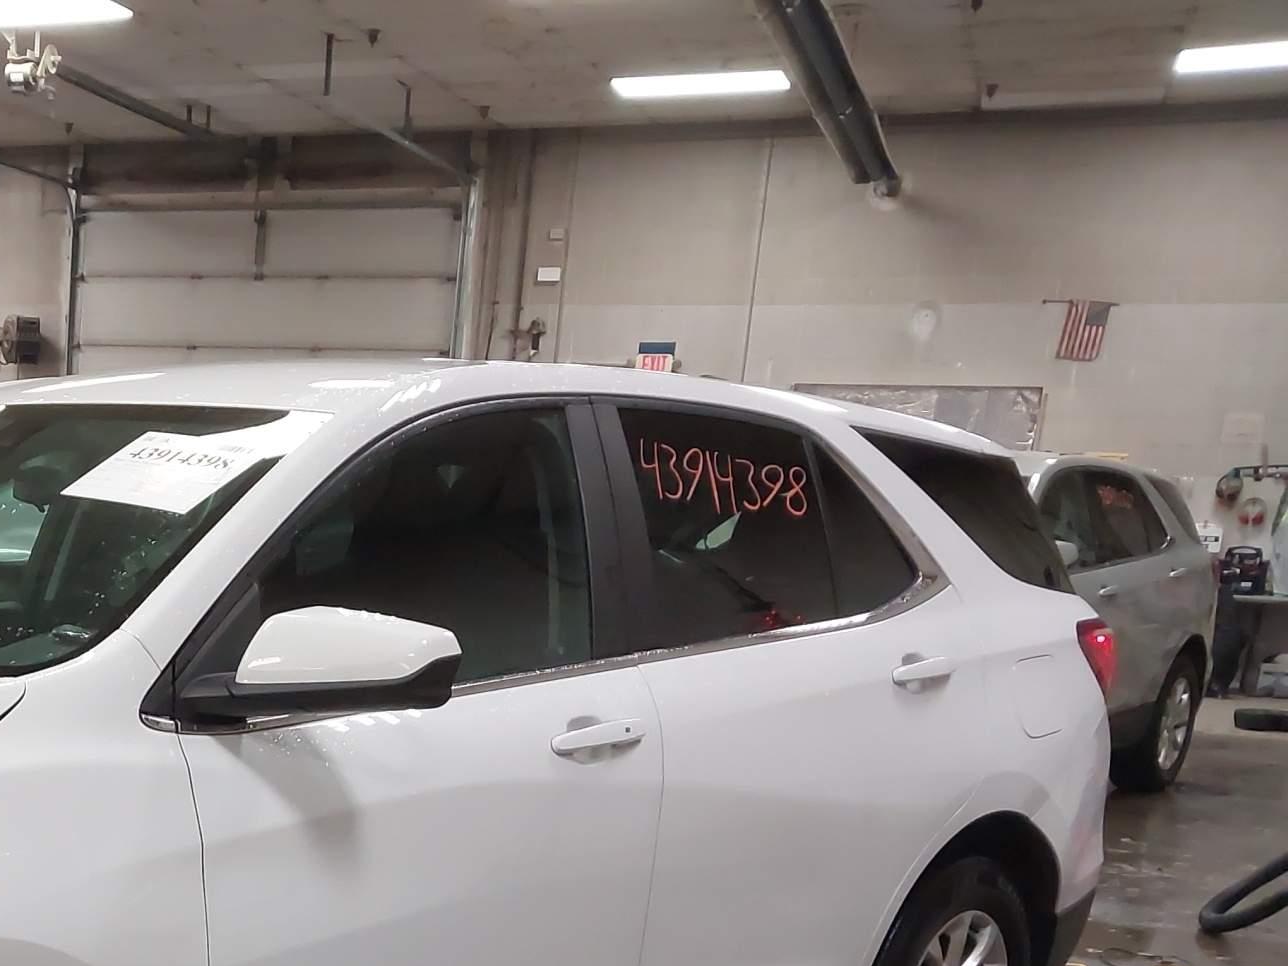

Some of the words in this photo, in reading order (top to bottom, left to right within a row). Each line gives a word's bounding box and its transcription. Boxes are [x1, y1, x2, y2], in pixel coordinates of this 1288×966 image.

[642, 355, 668, 371] EXIT
[129, 446, 235, 471] 43914398
[640, 437, 808, 516] 43914398
